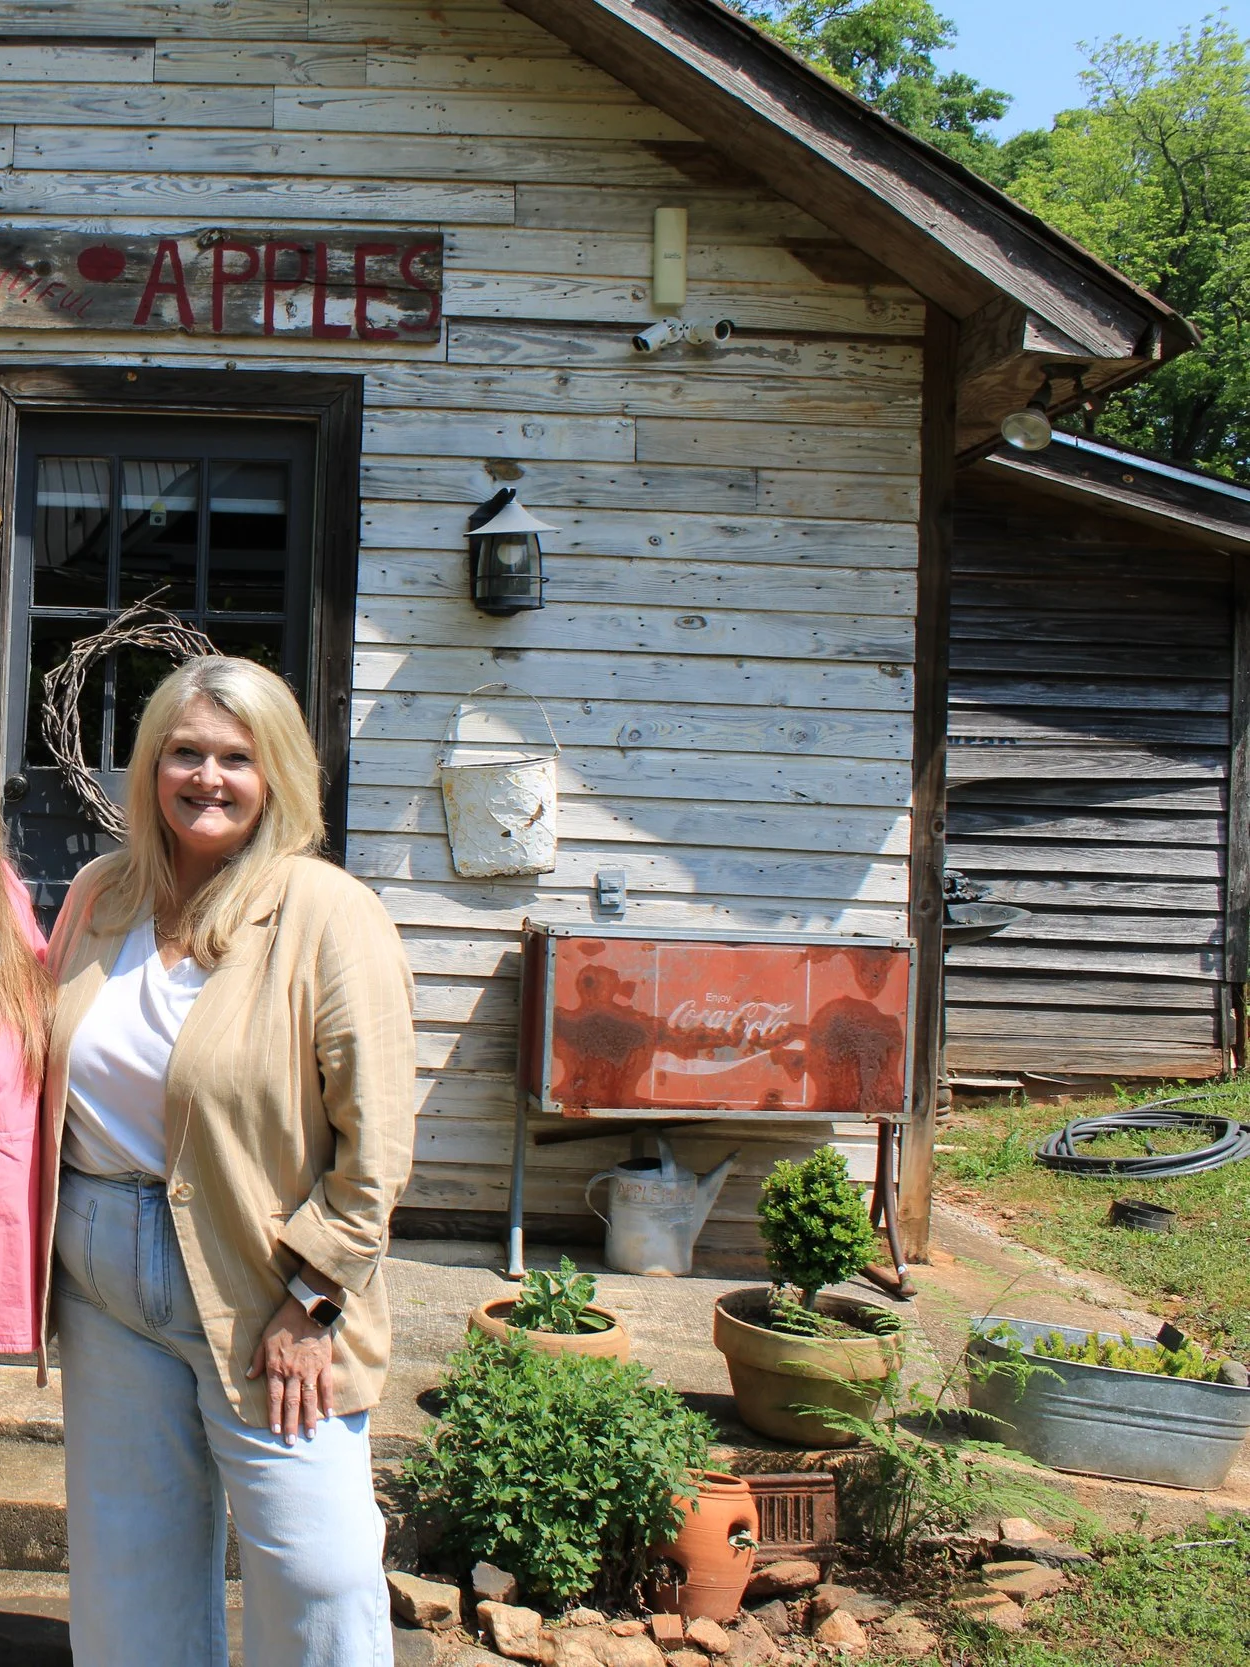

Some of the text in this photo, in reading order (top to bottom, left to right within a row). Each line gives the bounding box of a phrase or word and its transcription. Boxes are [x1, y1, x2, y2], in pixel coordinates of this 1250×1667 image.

[133, 239, 441, 340] APPLES
[705, 992, 732, 1005] Enjoy
[667, 999, 795, 1040] Coca-Cola
[616, 1182, 659, 1202] APPLE
